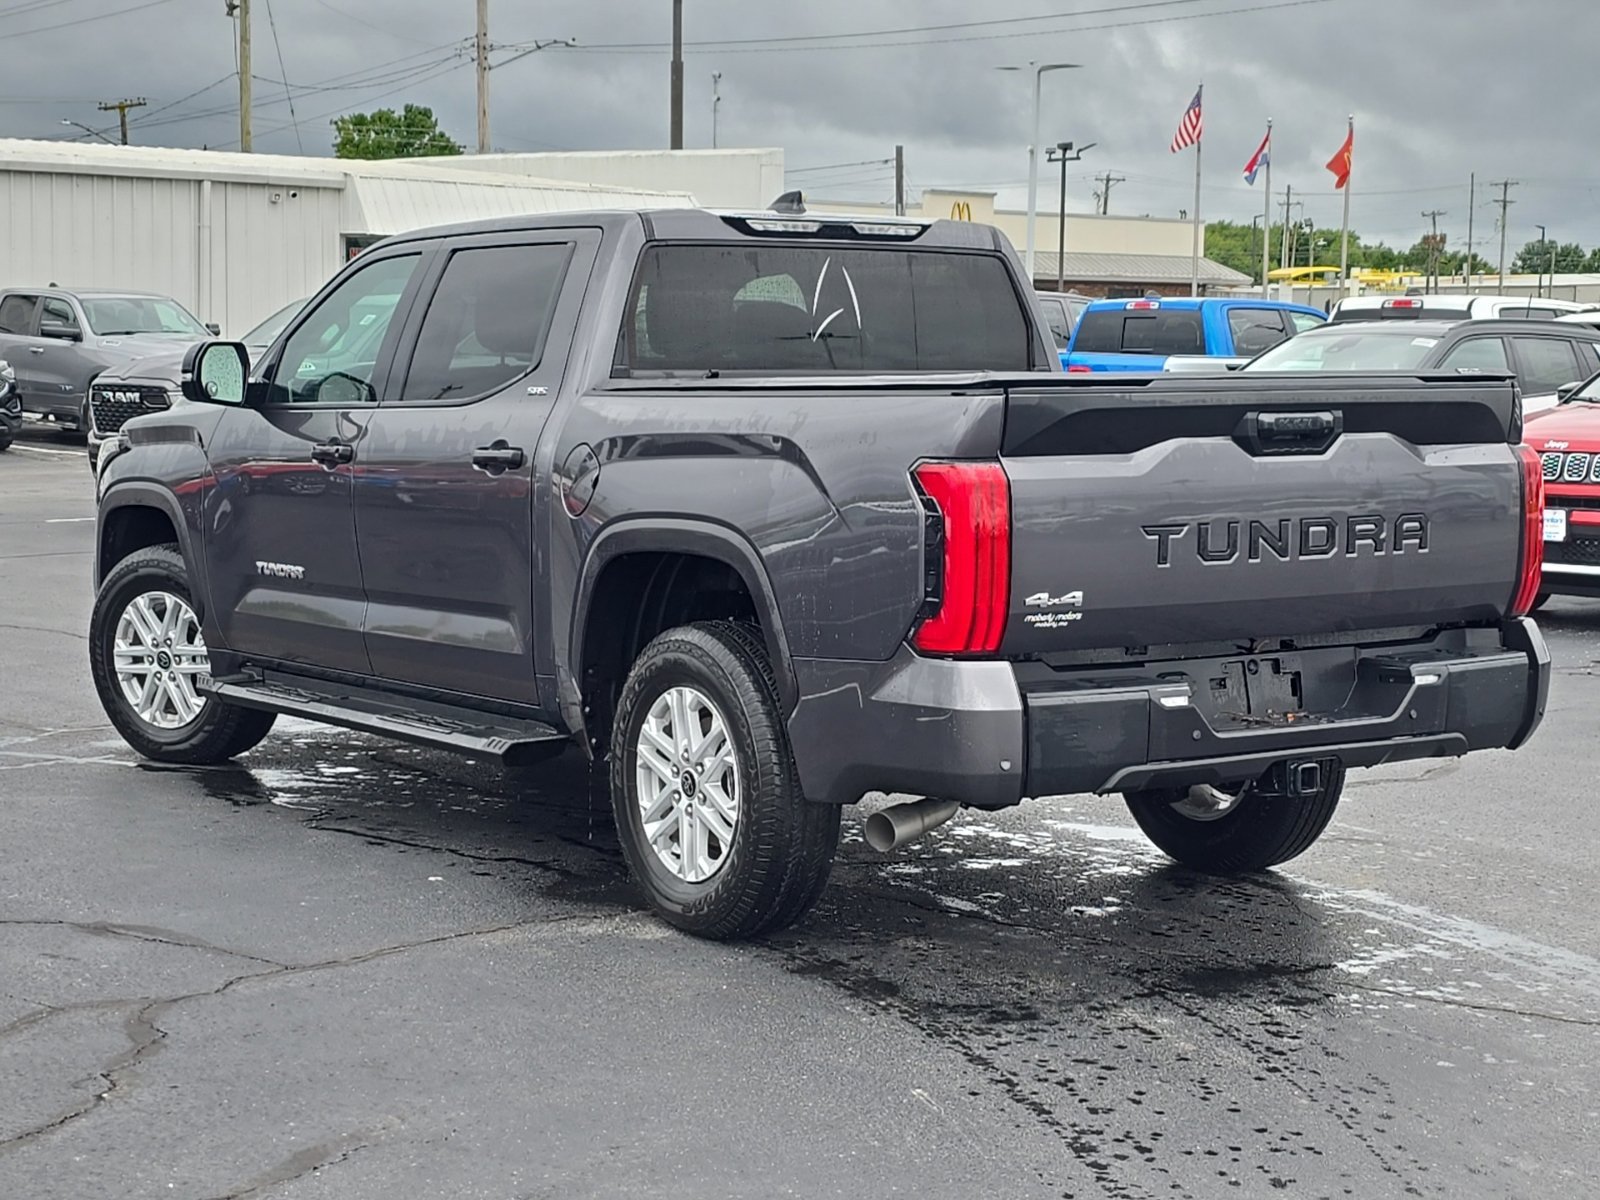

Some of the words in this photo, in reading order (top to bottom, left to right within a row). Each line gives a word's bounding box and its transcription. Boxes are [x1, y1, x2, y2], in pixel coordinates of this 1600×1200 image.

[101, 391, 140, 403] RAM
[1544, 440, 1569, 449] Jeep
[1140, 512, 1430, 567] TUNDRA
[255, 561, 306, 579] TUNDRA
